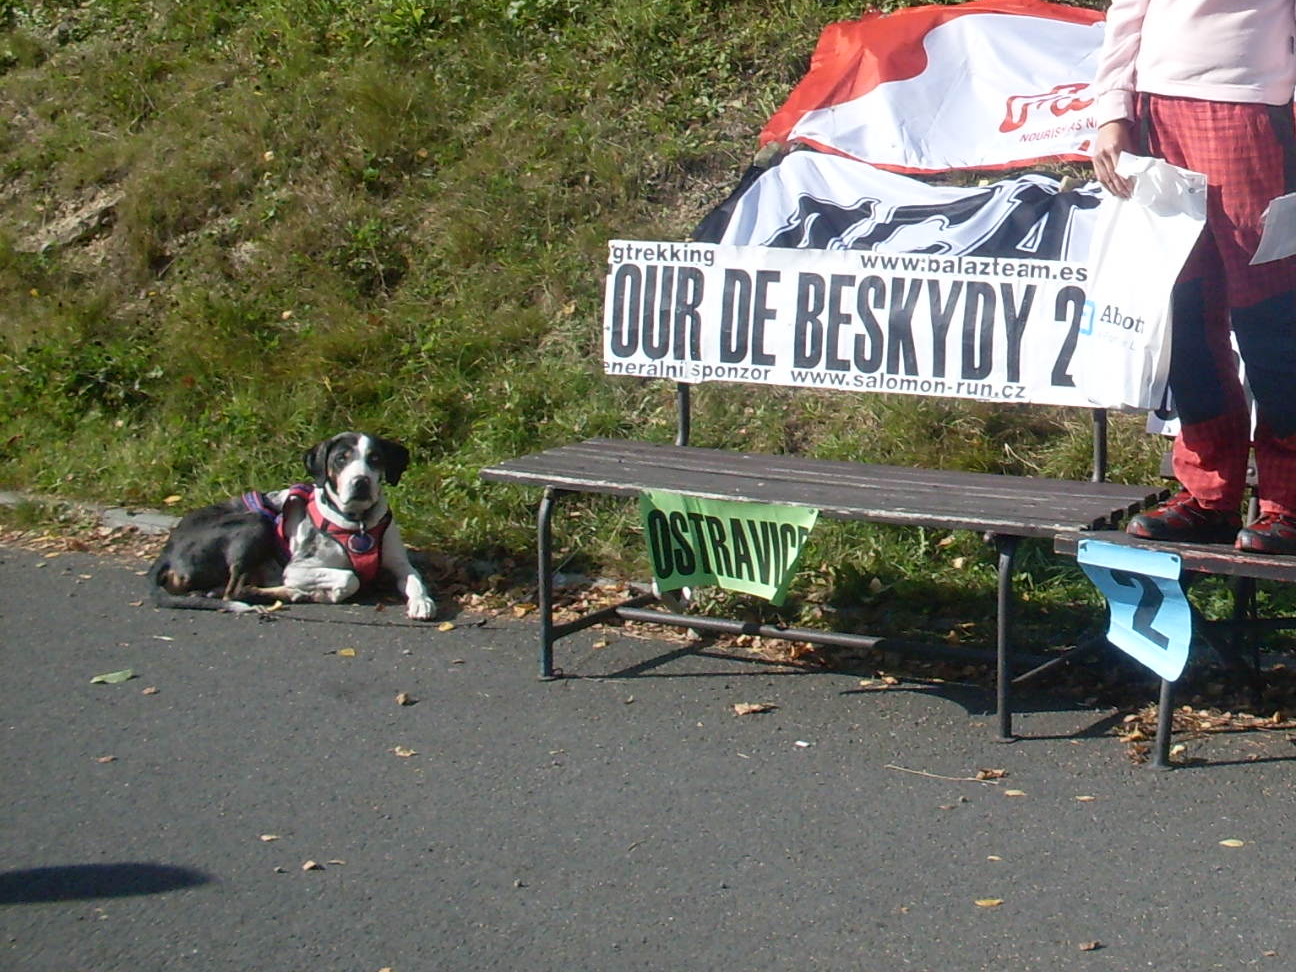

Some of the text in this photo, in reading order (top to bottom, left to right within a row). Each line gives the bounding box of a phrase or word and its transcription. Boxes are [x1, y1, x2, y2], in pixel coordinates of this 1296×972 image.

[608, 263, 1086, 387] OUR DE BESKYDY 2
[690, 365, 771, 383] sponzor
[791, 369, 1026, 399] www.salomon-run.cz
[1110, 569, 1170, 651] 2
